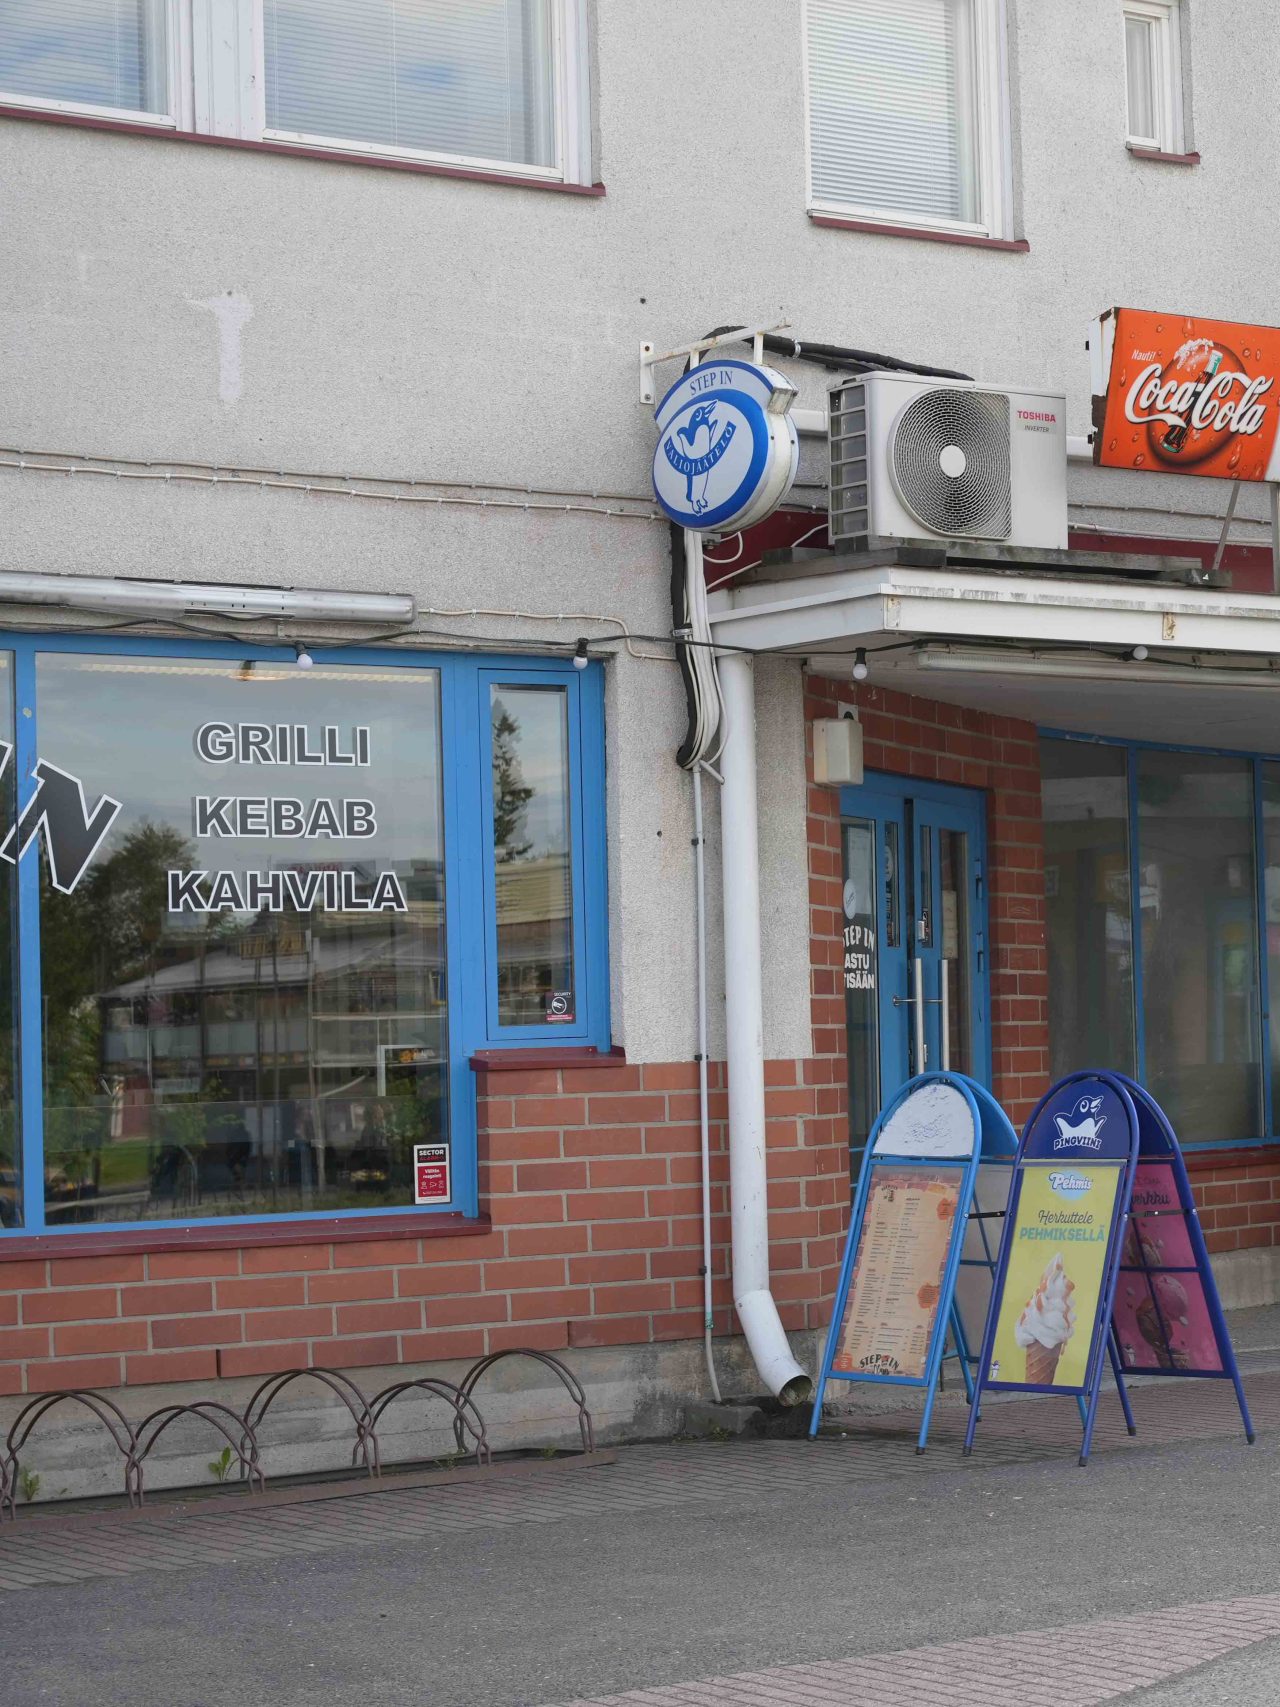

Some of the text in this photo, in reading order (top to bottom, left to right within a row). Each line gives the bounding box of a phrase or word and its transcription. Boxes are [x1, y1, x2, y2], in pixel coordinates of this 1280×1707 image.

[1131, 349, 1157, 362] Nauti!
[689, 370, 734, 396] STEP IN
[1125, 363, 1275, 435] Coca-Cola
[1016, 410, 1057, 423] TOSHIBA
[1024, 424, 1050, 433] INVERTER
[195, 721, 371, 766] GRILLI
[0, 740, 123, 895] N
[194, 795, 378, 839] KEBAB
[166, 870, 409, 912] KAHVILA
[863, 928, 875, 952] IN
[844, 953, 870, 969] ASTU
[844, 970, 875, 989] ISÄÄN
[1053, 1135, 1103, 1150] PINGVIINI
[1049, 1172, 1092, 1190] Pehmis
[1037, 1209, 1094, 1225] Herkuttele
[1019, 1224, 1106, 1242] PEHMIKSELLÄ
[859, 1353, 882, 1369] STEP
